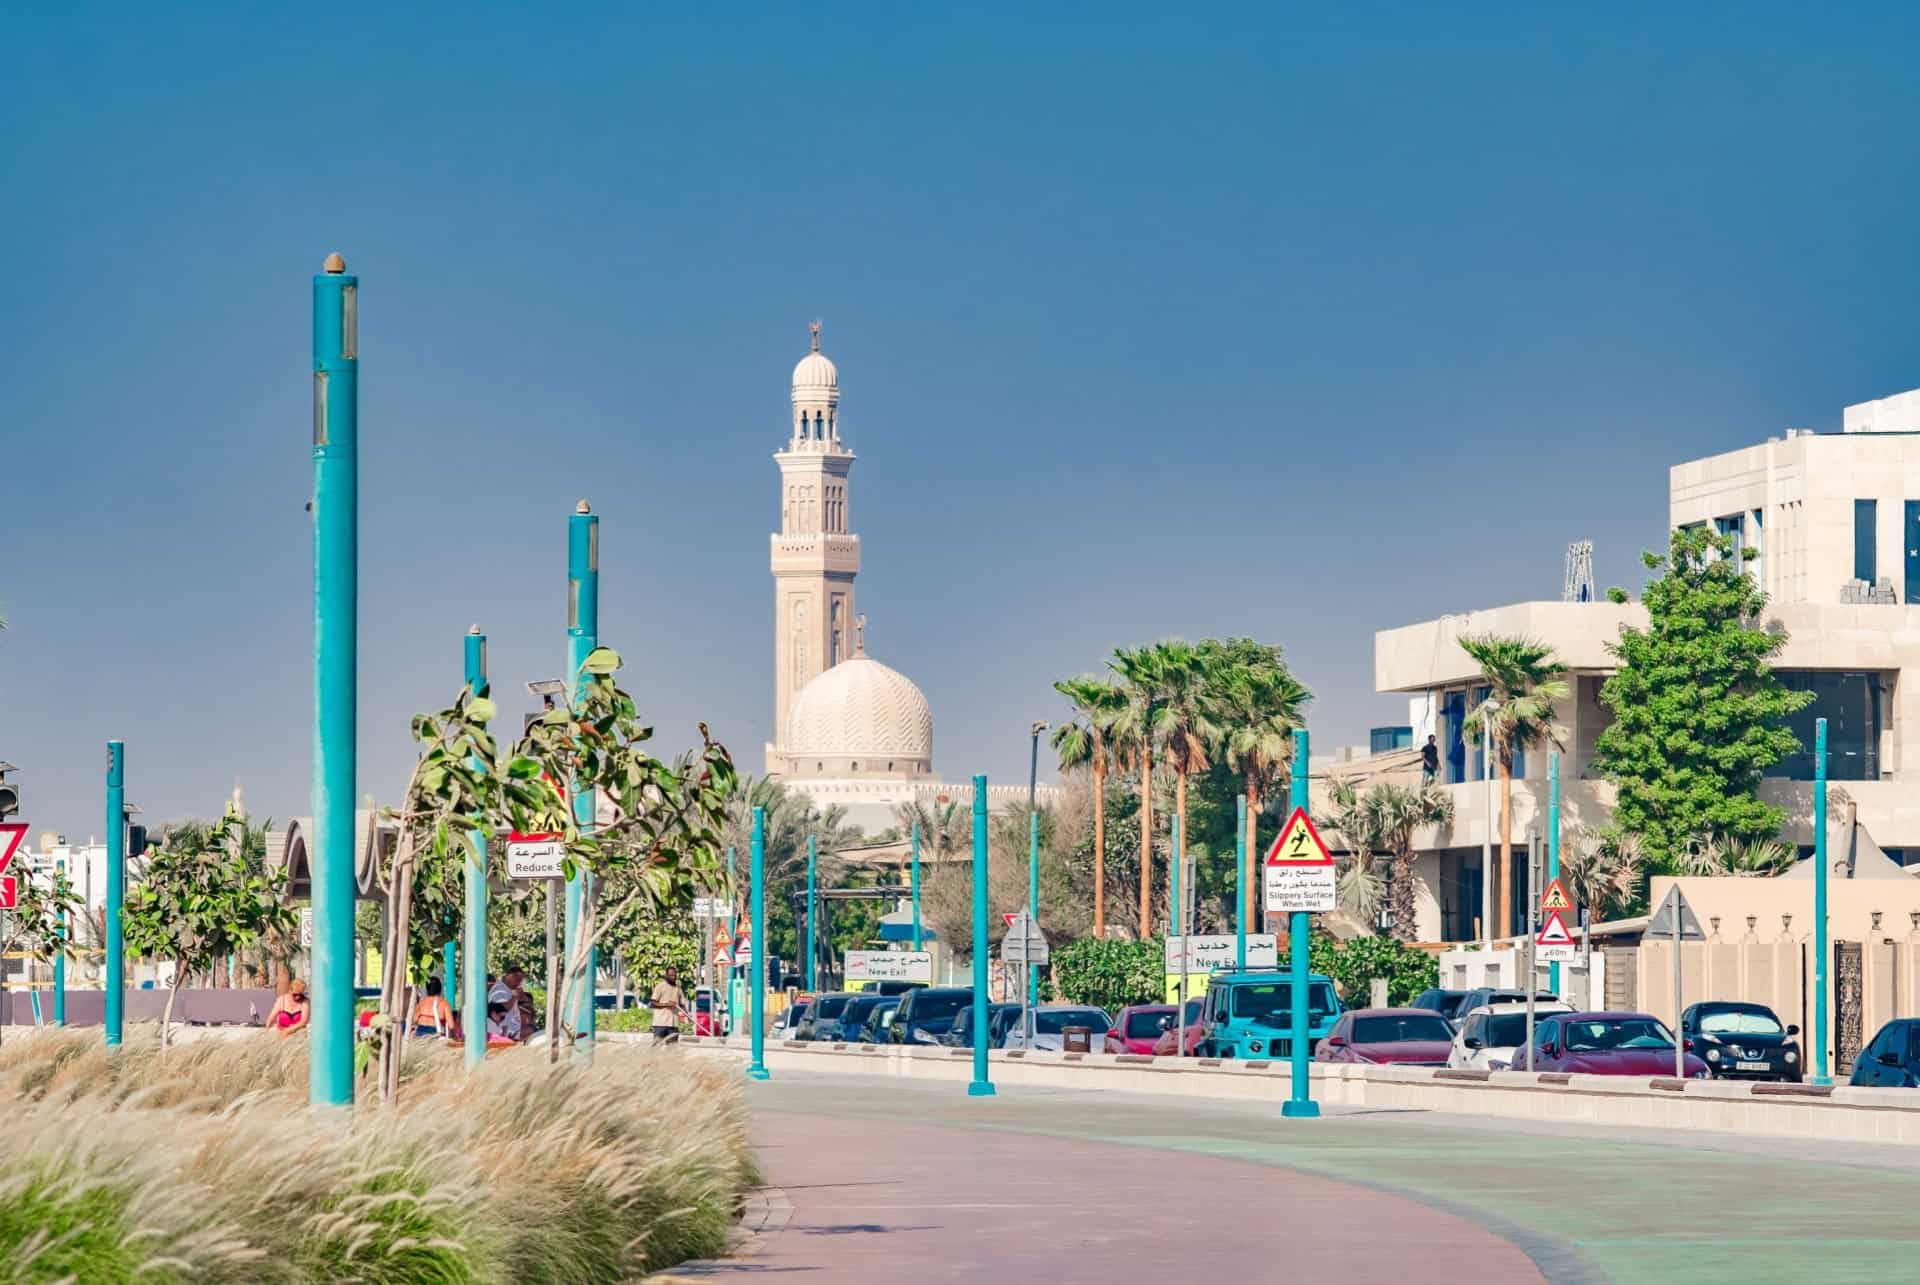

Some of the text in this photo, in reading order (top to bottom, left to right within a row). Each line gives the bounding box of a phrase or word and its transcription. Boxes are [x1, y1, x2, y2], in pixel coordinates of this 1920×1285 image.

[515, 847, 554, 858] السرعة
[515, 863, 553, 872] Reduce
[1268, 890, 1334, 899] Slippery Surface
[1195, 958, 1220, 968] New
[868, 967, 907, 976] New Exit
